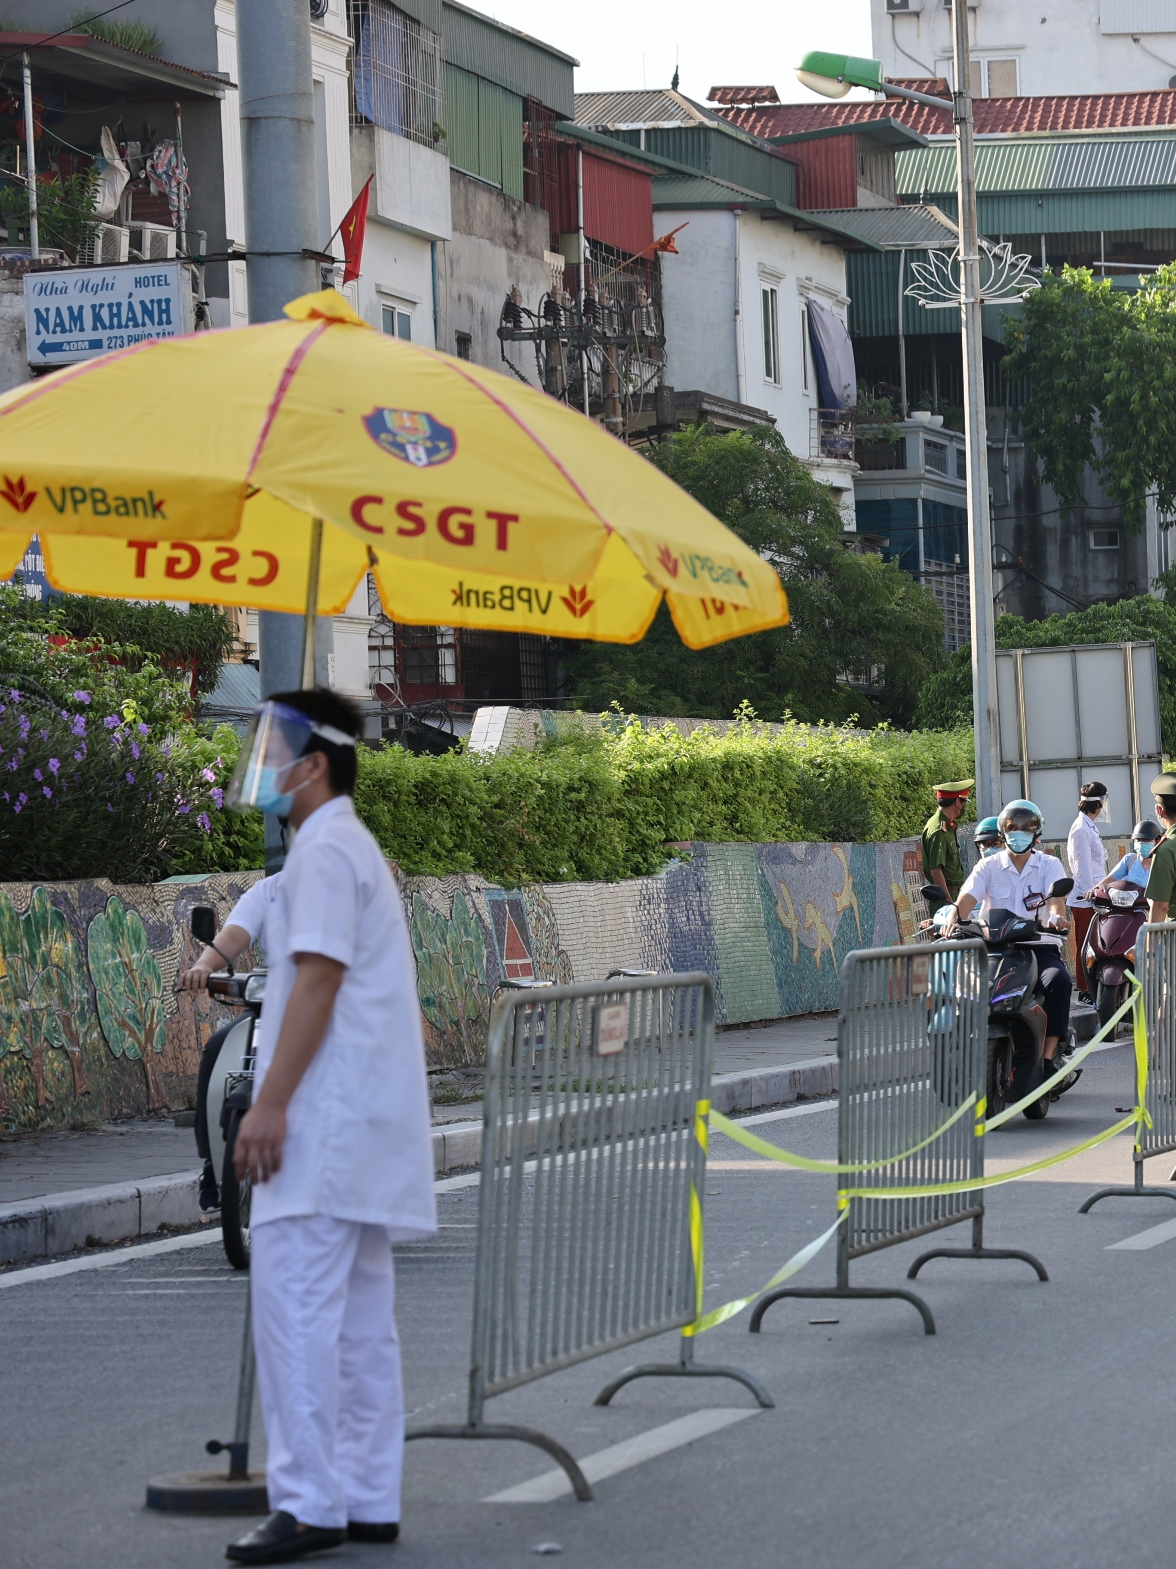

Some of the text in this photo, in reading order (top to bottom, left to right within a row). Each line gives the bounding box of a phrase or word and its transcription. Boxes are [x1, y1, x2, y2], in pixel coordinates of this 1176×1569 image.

[32, 281, 69, 297] Nhà
[134, 274, 171, 289] HOTEL
[33, 292, 173, 336] NAM KHÁNH
[62, 341, 90, 351] 40M
[106, 336, 125, 349] 273
[45, 486, 168, 520] VPBank
[350, 495, 520, 552] CSGT
